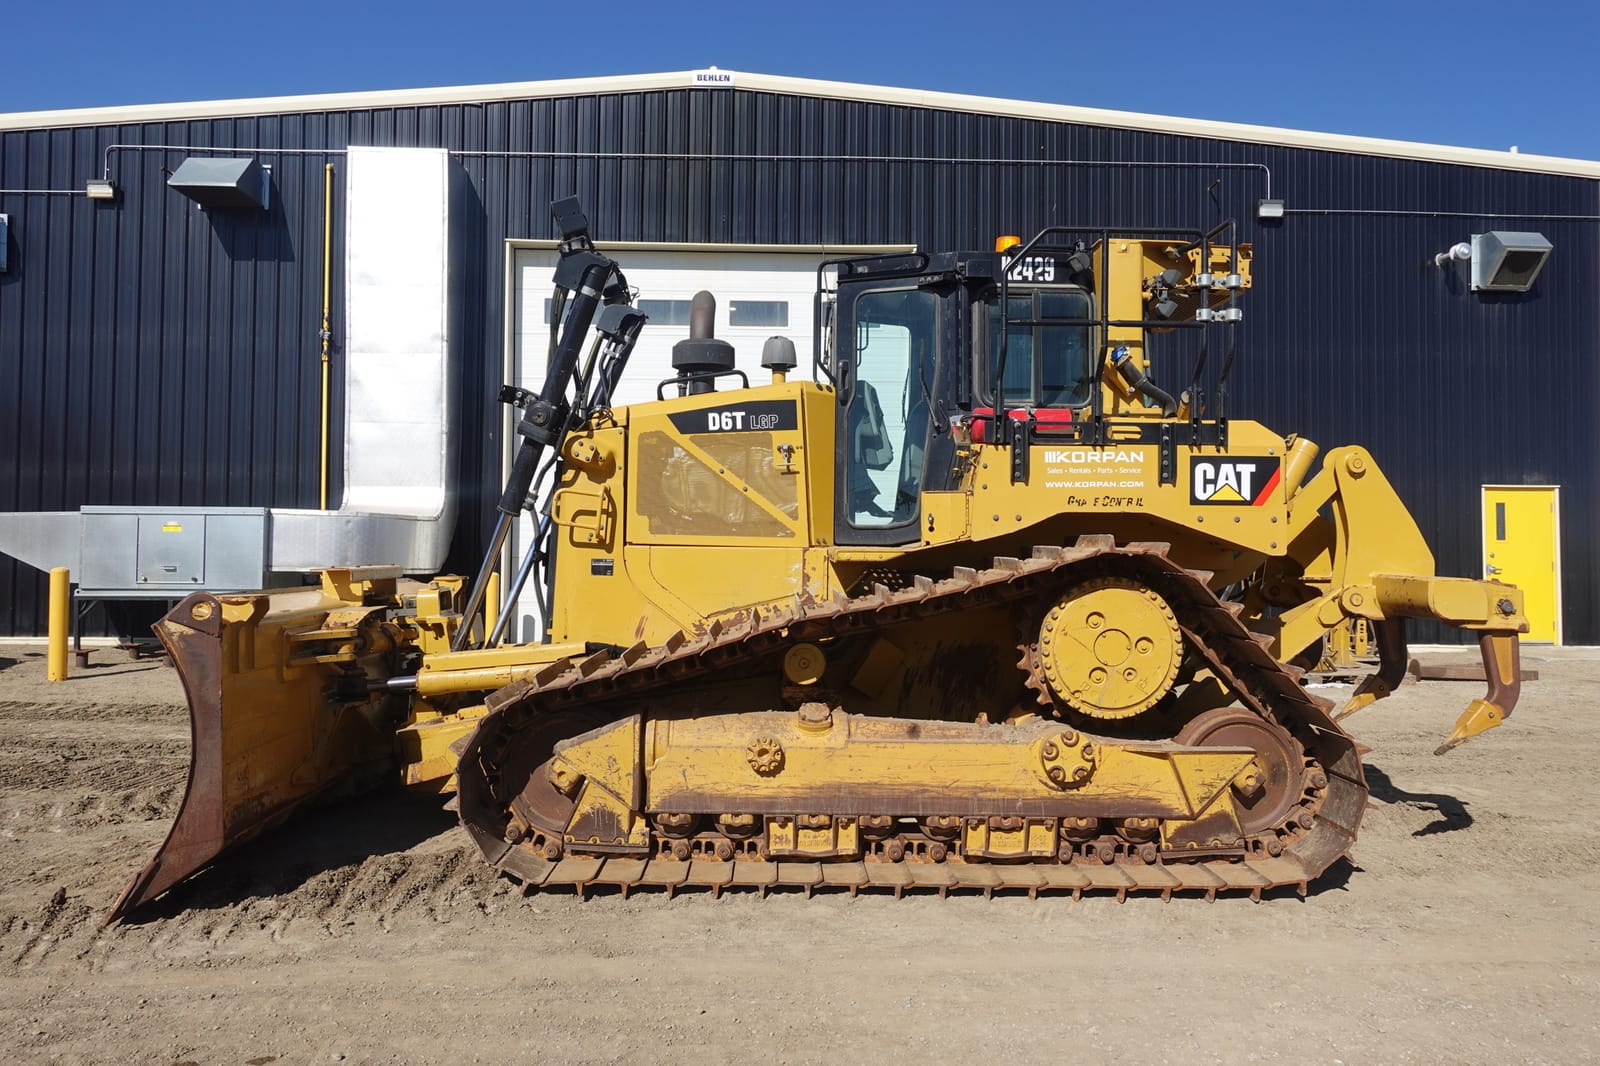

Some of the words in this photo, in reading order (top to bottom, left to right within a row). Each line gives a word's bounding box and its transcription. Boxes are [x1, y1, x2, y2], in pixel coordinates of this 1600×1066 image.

[697, 74, 730, 82] BEHLEN
[1001, 255, 1055, 281] K2429
[707, 411, 746, 431] D6T
[750, 414, 779, 430] LGP
[1044, 451, 1144, 463] KORPAN
[1194, 462, 1257, 501] CAT
